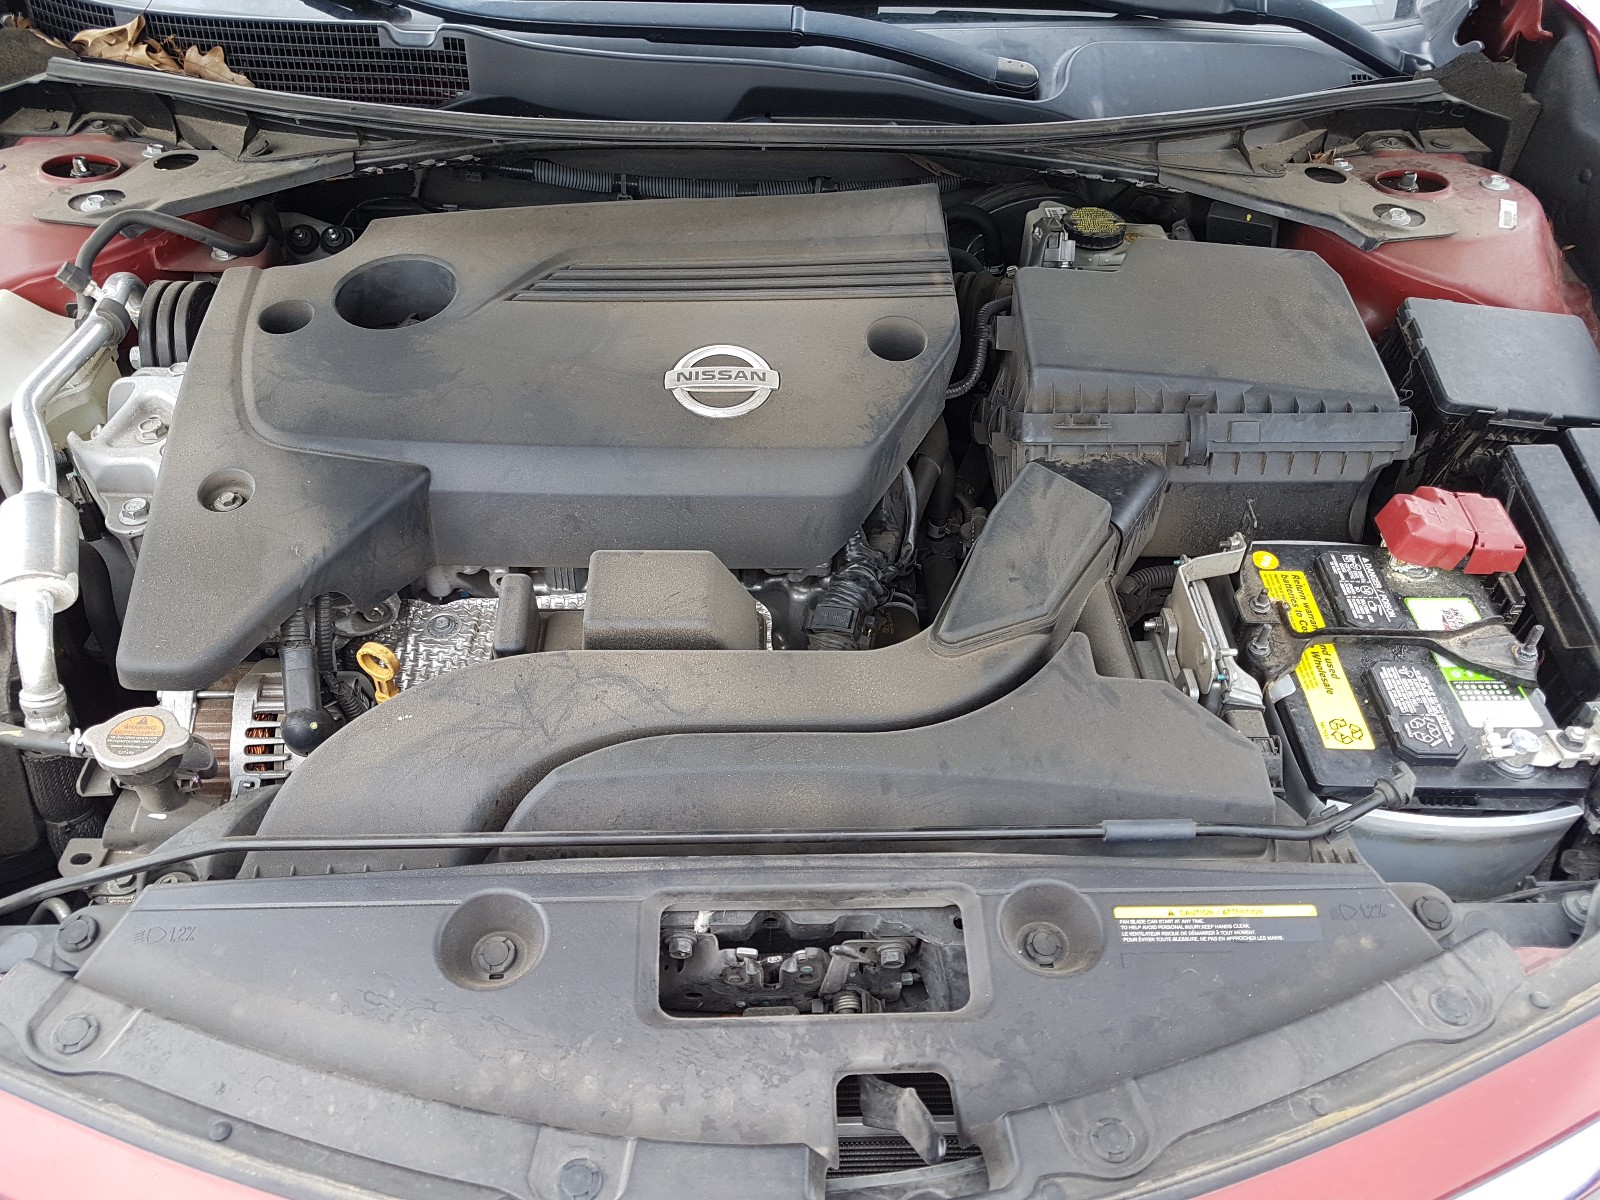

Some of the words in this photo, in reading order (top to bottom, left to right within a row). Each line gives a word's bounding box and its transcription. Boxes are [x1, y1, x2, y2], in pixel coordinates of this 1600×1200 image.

[677, 370, 766, 382] NISSAN
[1292, 574, 1307, 600] Return
[1364, 563, 1382, 588] DANGER
[1379, 594, 1396, 618] POISON
[1303, 602, 1318, 631] warran
[1281, 574, 1299, 608] batteries
[1295, 609, 1302, 618] to
[1311, 651, 1334, 695] Wholesale
[1320, 644, 1331, 657] nd
[1325, 659, 1340, 680] used
